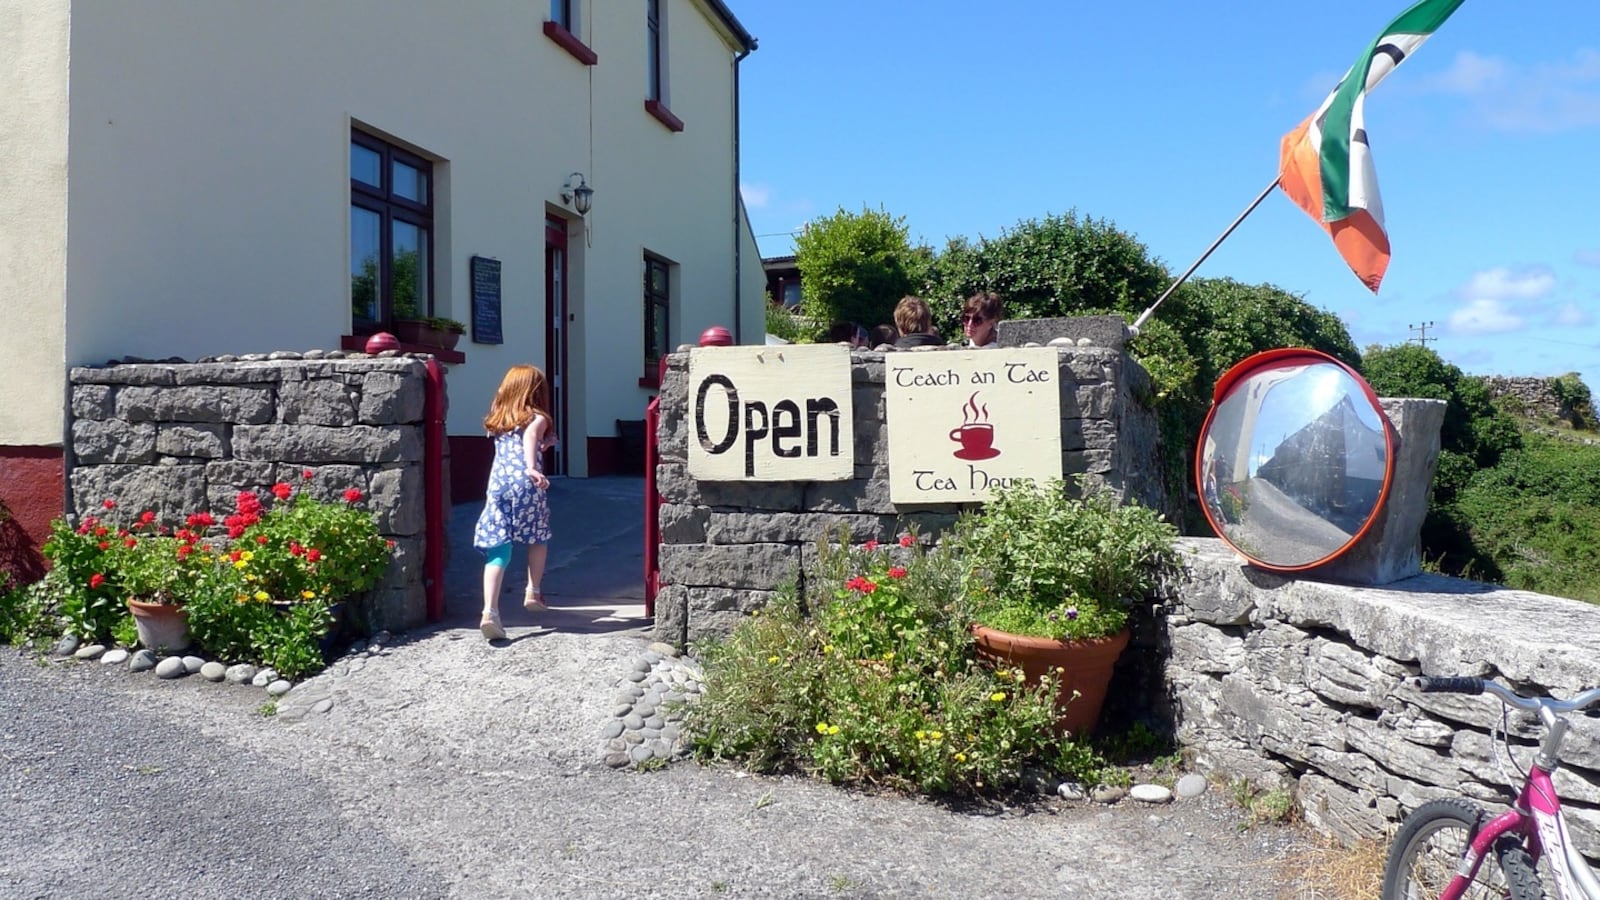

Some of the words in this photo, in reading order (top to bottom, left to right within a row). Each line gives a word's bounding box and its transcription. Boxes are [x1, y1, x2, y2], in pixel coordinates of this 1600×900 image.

[892, 367, 960, 387] Teach
[970, 371, 995, 384] an
[1004, 362, 1050, 384] Tae
[695, 374, 840, 477] Open
[912, 470, 958, 491] Tea
[967, 464, 1038, 490] Hou
